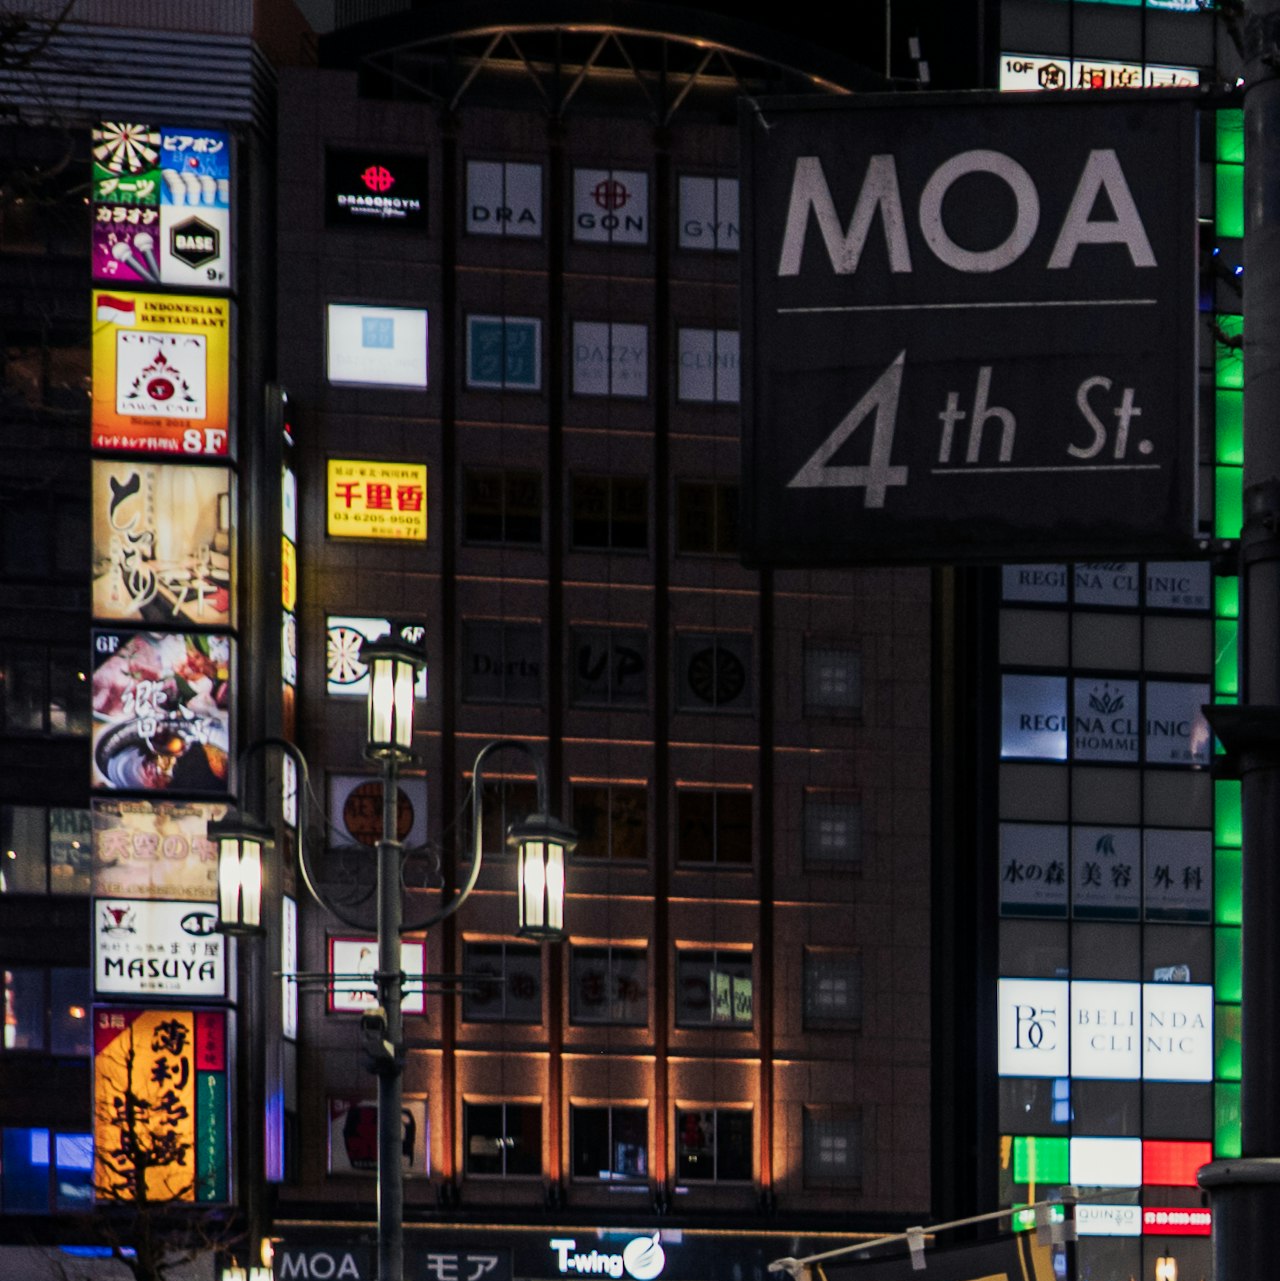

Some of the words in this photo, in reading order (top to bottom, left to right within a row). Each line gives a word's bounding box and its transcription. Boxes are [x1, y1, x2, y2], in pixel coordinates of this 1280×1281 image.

[1006, 60, 1034, 75] 10F
[96, 206, 159, 225] カラオケ
[472, 206, 536, 224] DRA
[778, 148, 1158, 276] MOA
[578, 213, 644, 232] GON
[175, 234, 214, 251] BASE
[206, 269, 225, 281] 9F
[144, 301, 223, 316] INDONESIAN
[141, 314, 226, 328] RESTAURANT
[122, 334, 200, 348] CINTA
[786, 348, 1018, 508] 4th
[1067, 375, 1154, 460] St.
[182, 427, 226, 455] 8F
[334, 481, 424, 512] 千里香
[406, 527, 420, 537] 7F
[1018, 570, 1104, 589] REGINA
[1112, 575, 1191, 593] CLINIC
[96, 636, 119, 652] 6F
[1019, 713, 1106, 735] REGINA
[1111, 718, 1192, 738] CLINIC
[1075, 737, 1139, 752] HOMME
[104, 957, 215, 981] MASUYA
[1077, 1007, 1206, 1030] BELINDA
[1090, 1035, 1195, 1054] CLINIC
[279, 1251, 360, 1280] MOA
[549, 1238, 625, 1279] T-wing
